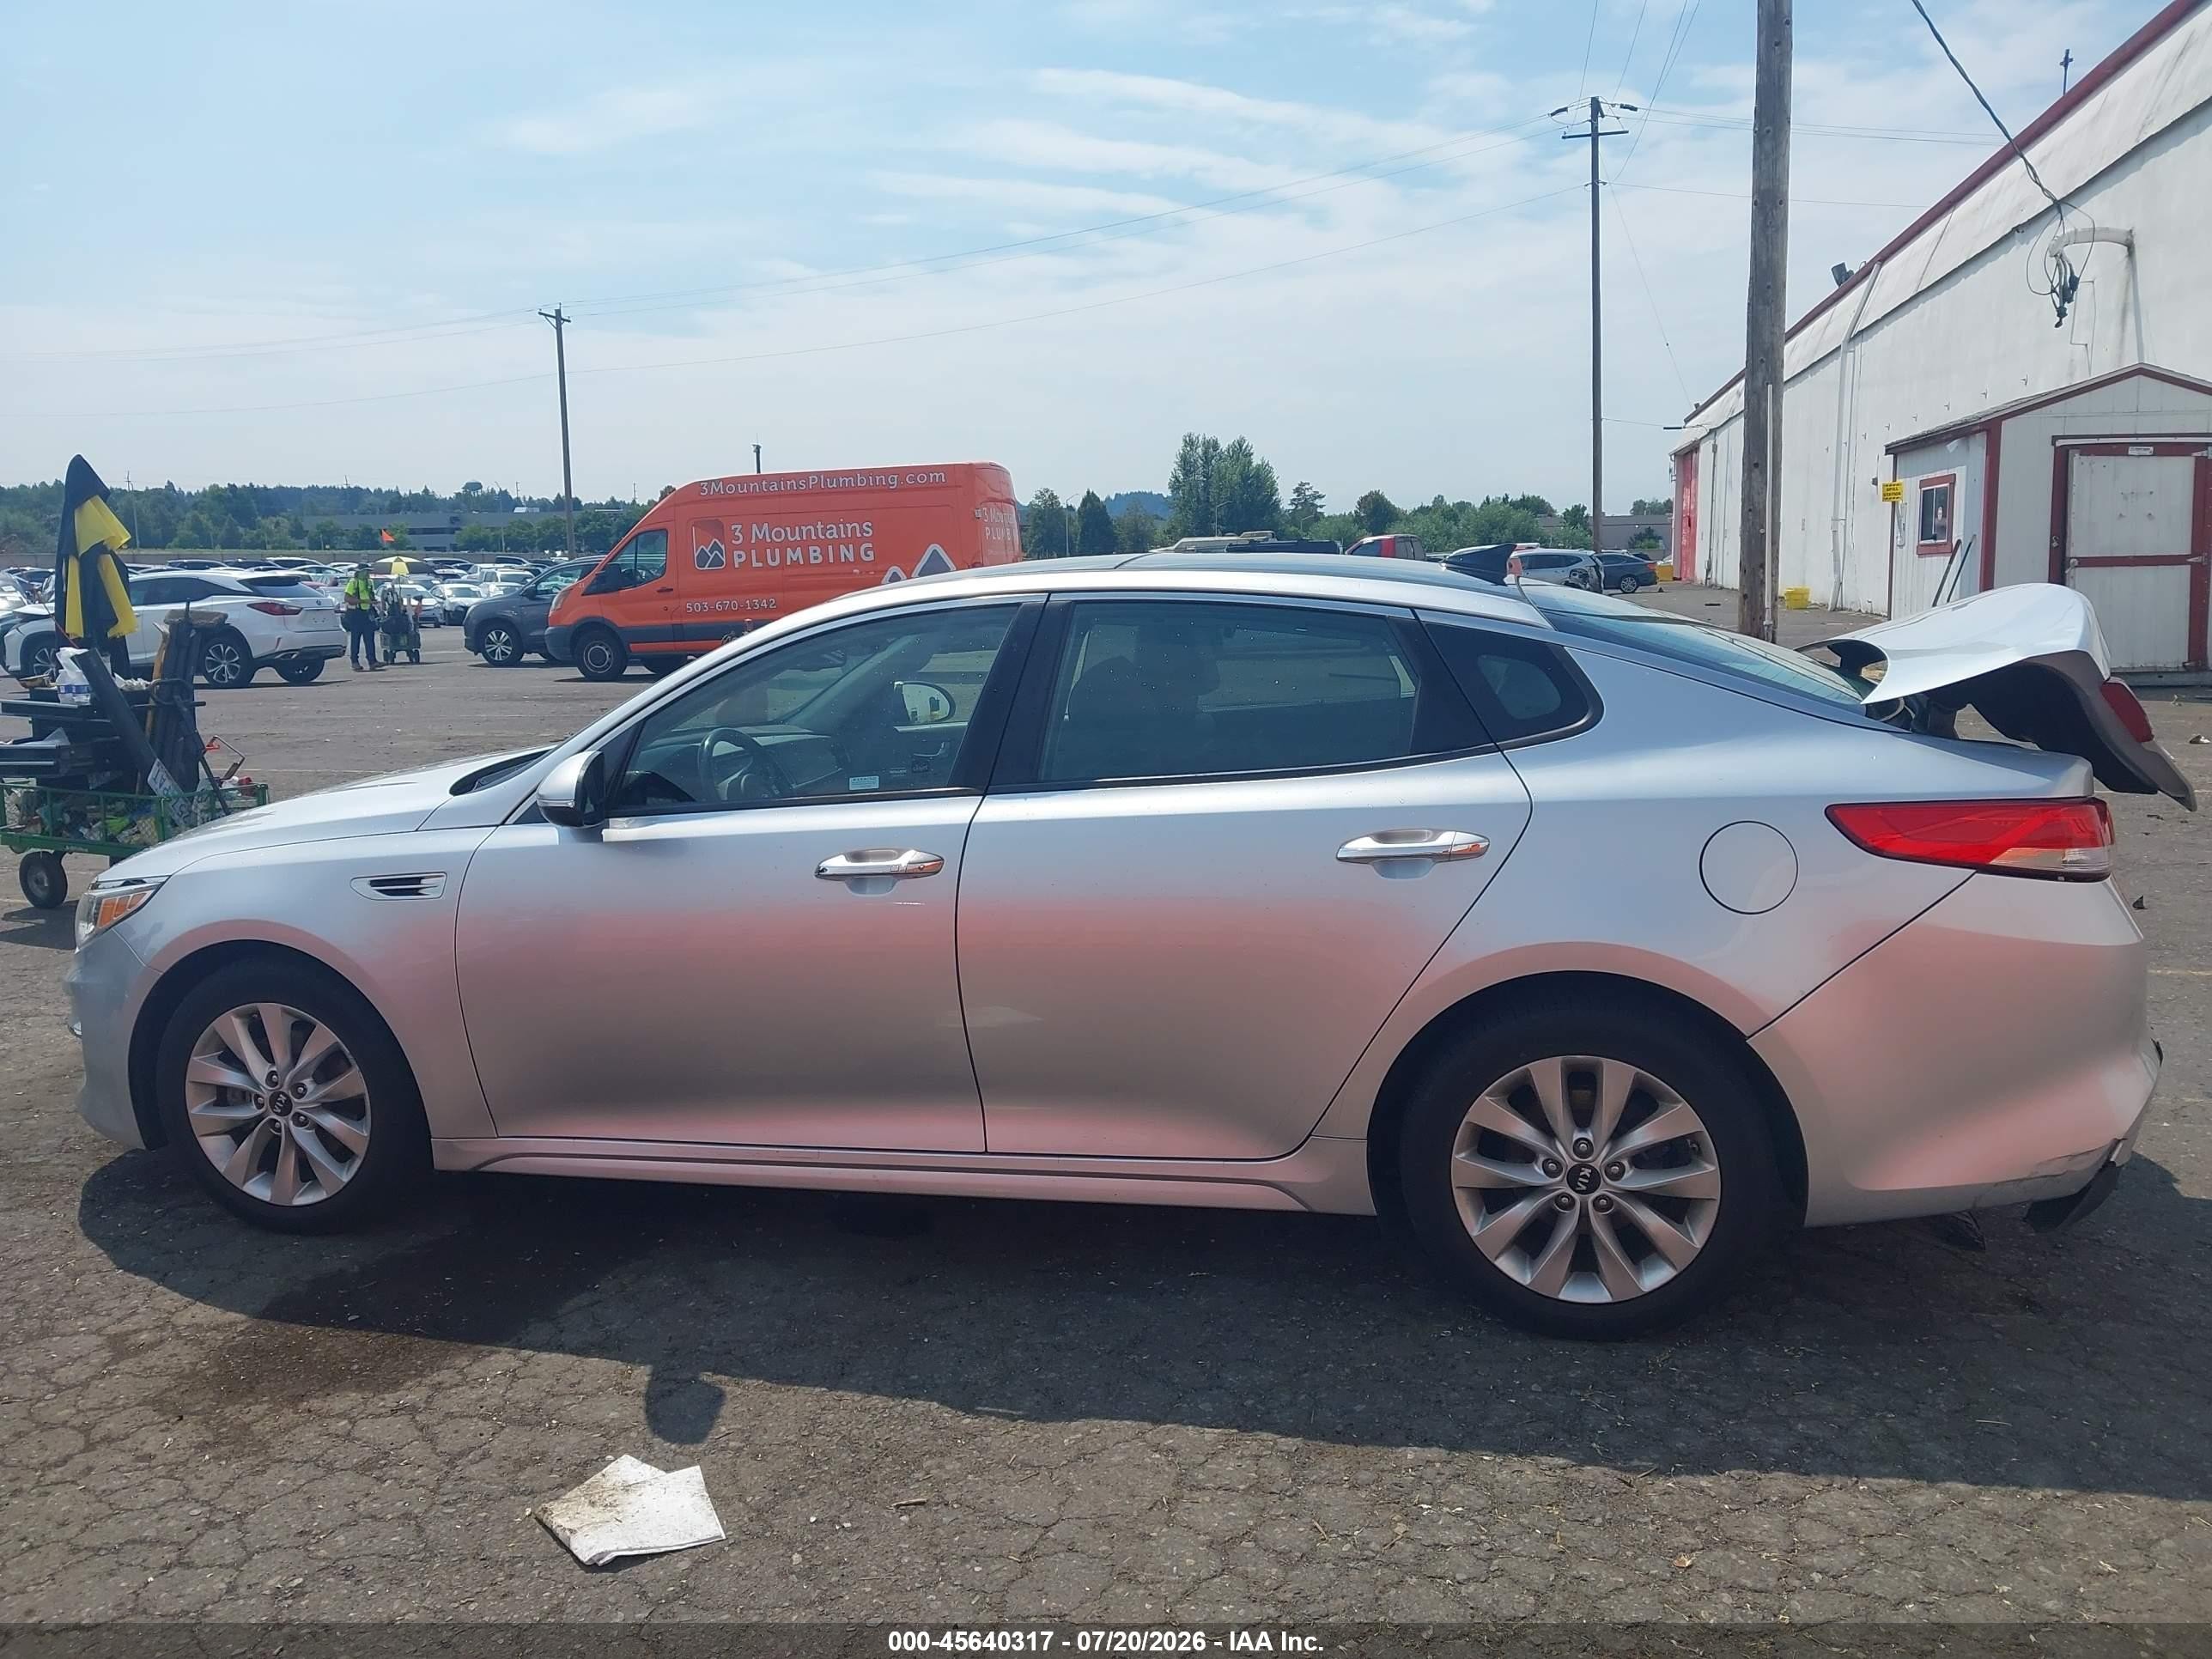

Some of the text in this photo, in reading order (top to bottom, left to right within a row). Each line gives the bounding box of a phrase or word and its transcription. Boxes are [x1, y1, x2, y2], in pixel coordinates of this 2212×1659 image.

[700, 471, 946, 496] 3MountainsPlumbing.com
[731, 518, 873, 545] 3 Mountains
[733, 543, 875, 568] PLUMBING
[686, 598, 777, 613] 503-670-1342
[273, 1094, 287, 1113] KIA
[1576, 1167, 1592, 1191] KIA
